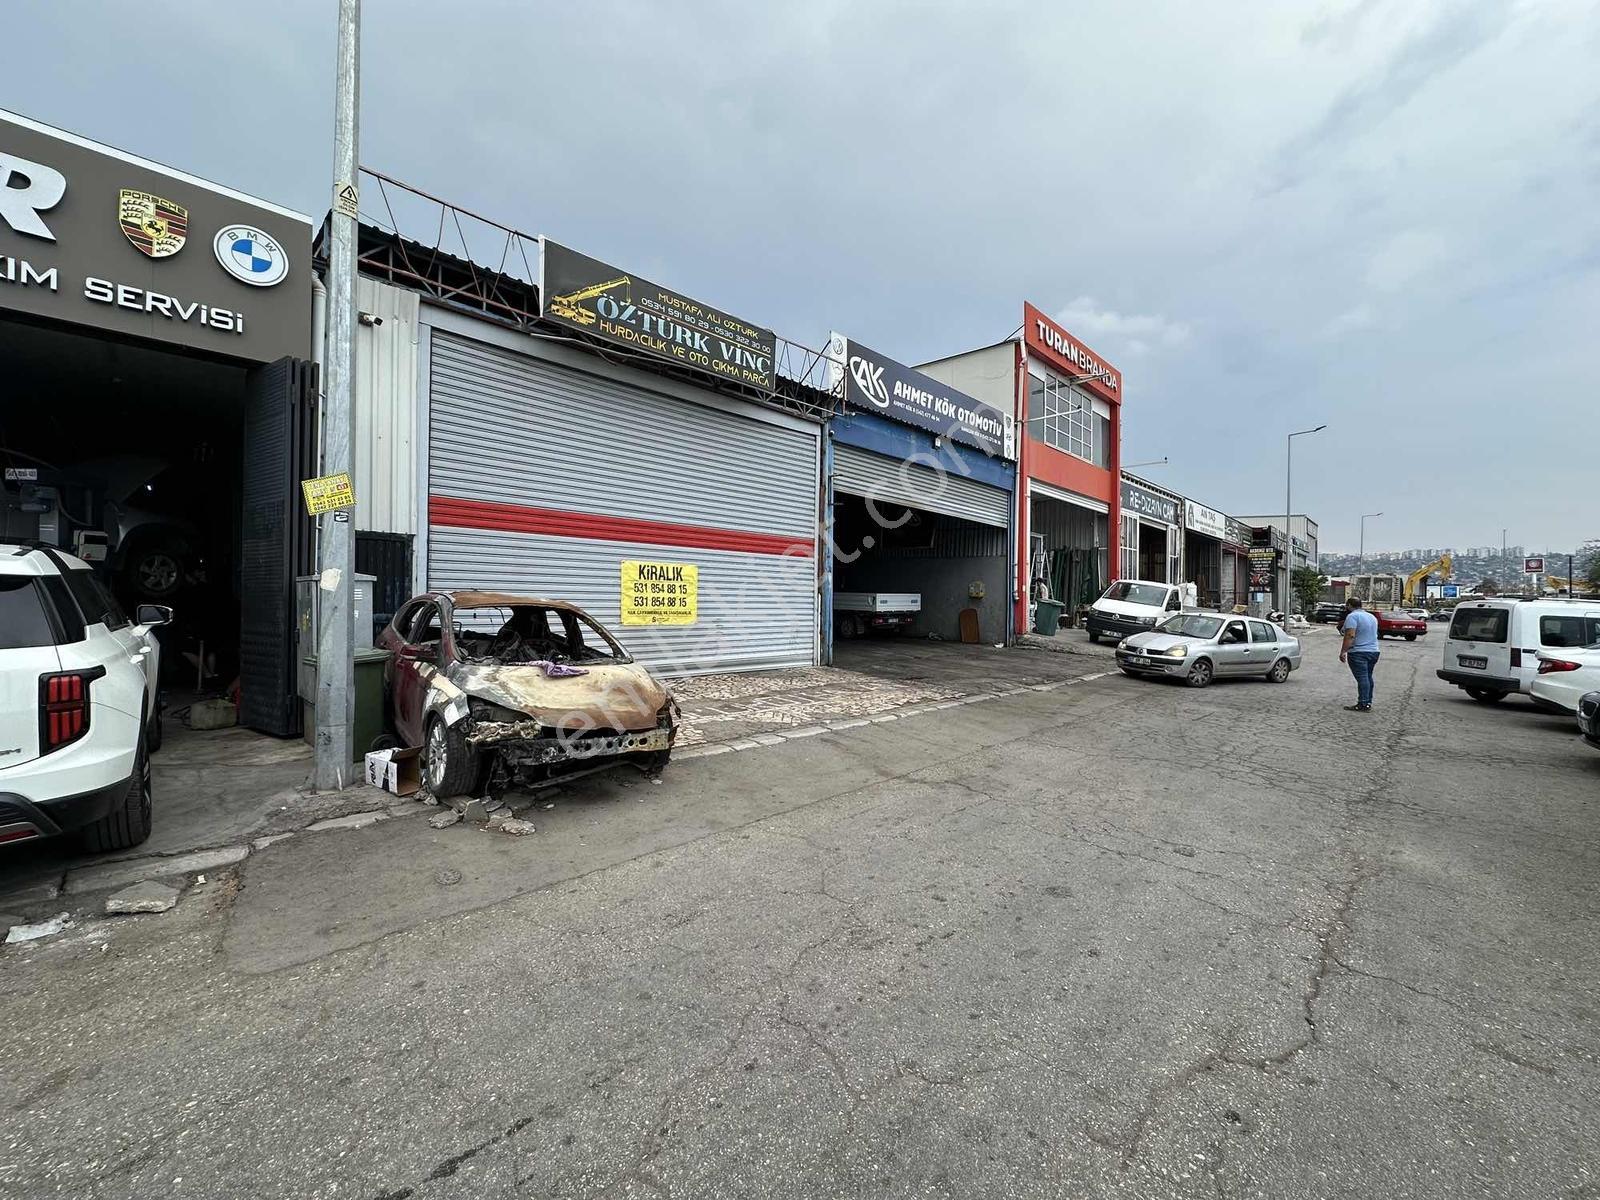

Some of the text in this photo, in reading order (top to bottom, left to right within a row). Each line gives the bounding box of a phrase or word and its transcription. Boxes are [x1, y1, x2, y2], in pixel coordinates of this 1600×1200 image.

[120, 189, 189, 215] PORSCHE
[226, 231, 277, 253] BMW
[0, 255, 58, 290] IM
[641, 297, 666, 313] 0534
[668, 307, 683, 319] 591
[684, 313, 696, 324] 80
[697, 318, 709, 329] 29
[658, 293, 704, 318] MUSTAFA
[597, 293, 772, 376] ÖZTÜRK VİNÇ
[600, 319, 667, 353] HURDACILIK
[671, 344, 686, 359] VE
[688, 351, 710, 366] OTO
[712, 359, 741, 378] ÇIKMA
[893, 380, 934, 409] AHMET
[934, 397, 957, 419] KÖK
[956, 406, 1004, 437] OTOMOTİV
[633, 582, 688, 595] 531 854 88 15
[633, 596, 688, 607] 531 854 88 15
